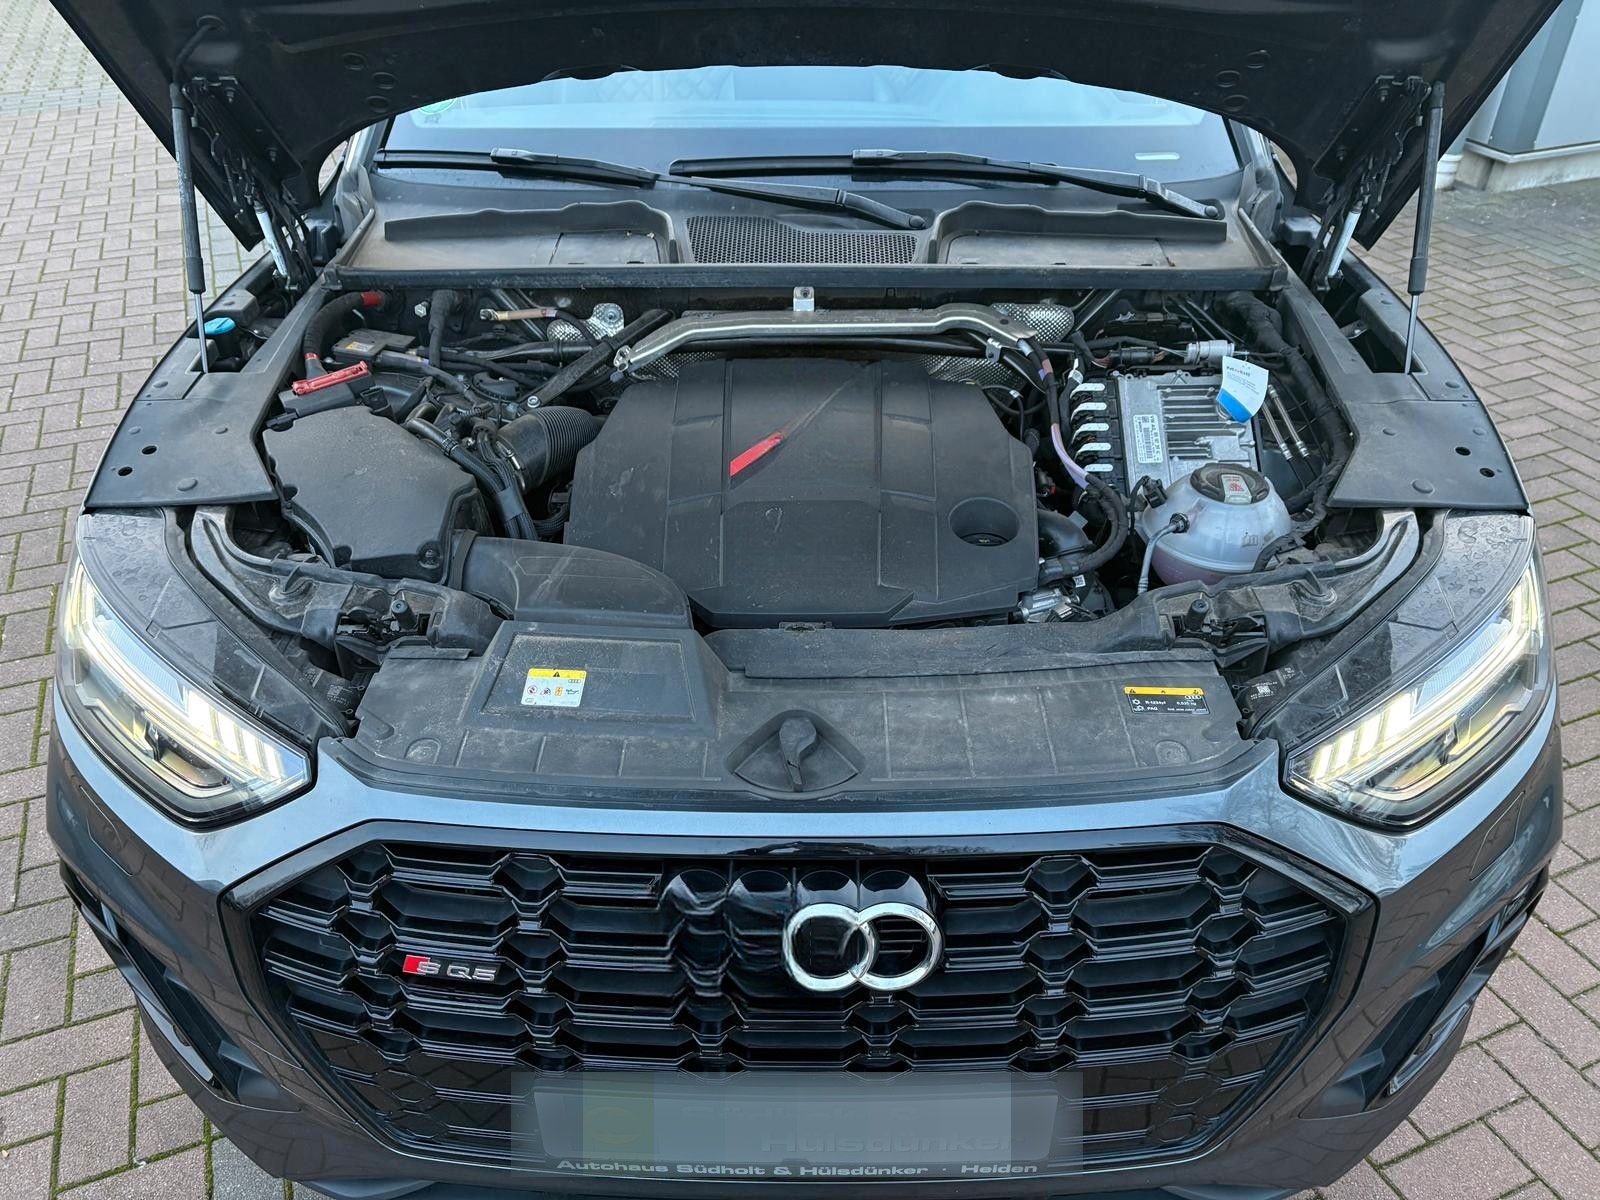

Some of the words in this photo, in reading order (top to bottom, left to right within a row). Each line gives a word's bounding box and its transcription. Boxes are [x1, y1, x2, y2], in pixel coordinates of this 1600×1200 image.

[556, 1159, 669, 1173] Autohaus
[676, 1163, 766, 1176] Südholt
[773, 1166, 793, 1176] &
[799, 1165, 929, 1176] Hülsdünker
[960, 1164, 1038, 1175] Heiden
